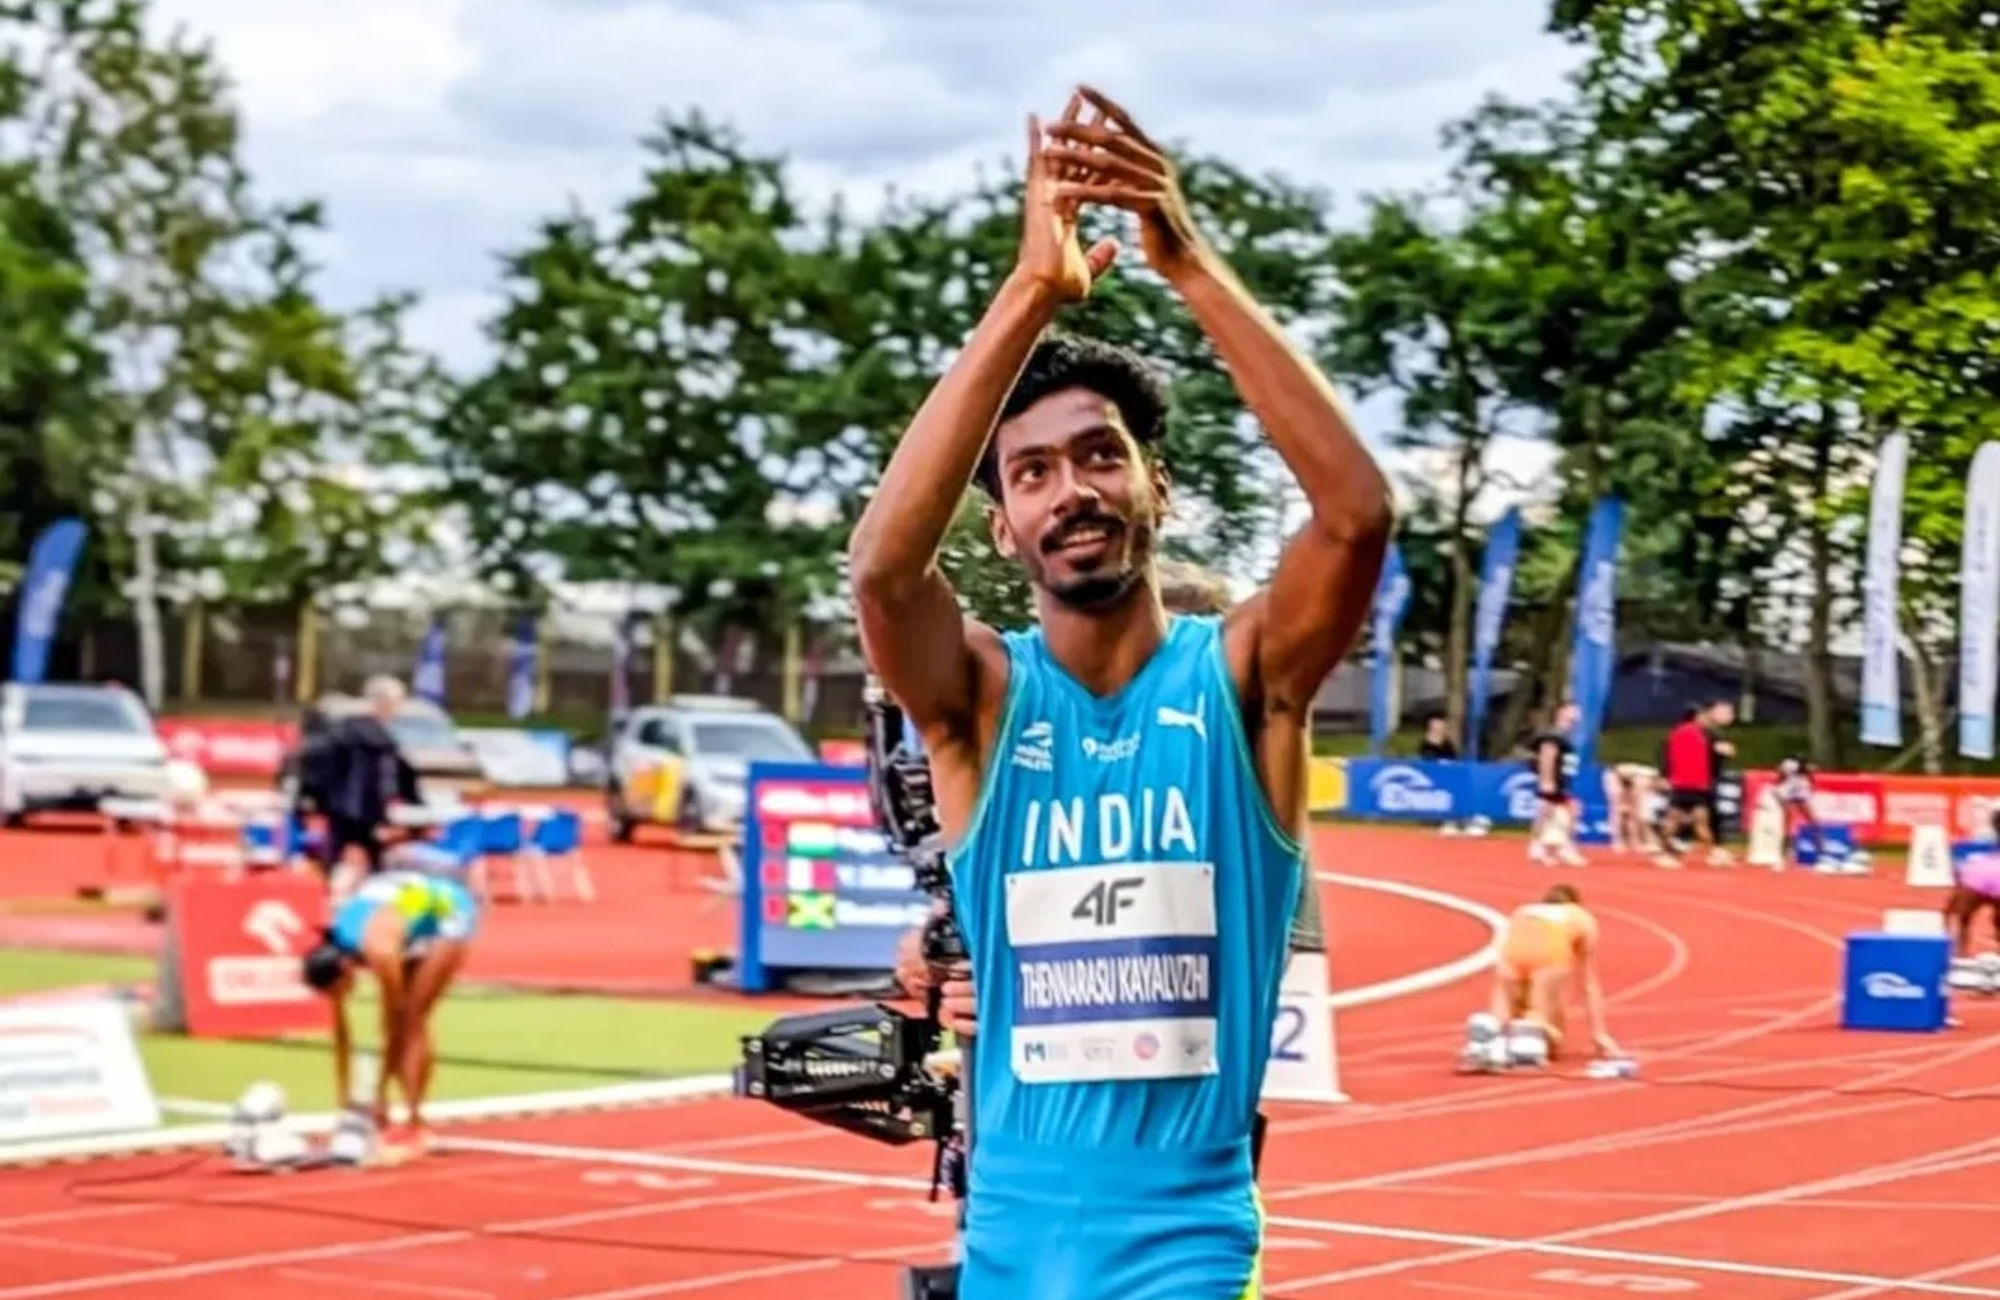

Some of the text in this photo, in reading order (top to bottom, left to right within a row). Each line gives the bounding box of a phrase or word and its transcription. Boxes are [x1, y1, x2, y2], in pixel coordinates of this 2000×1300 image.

[1021, 786, 1197, 866] INDIA
[1071, 877, 1145, 925] 4F
[1020, 953, 1210, 1010] THENNARASU KAYALVIZHI
[1271, 1005, 1307, 1061] 2
